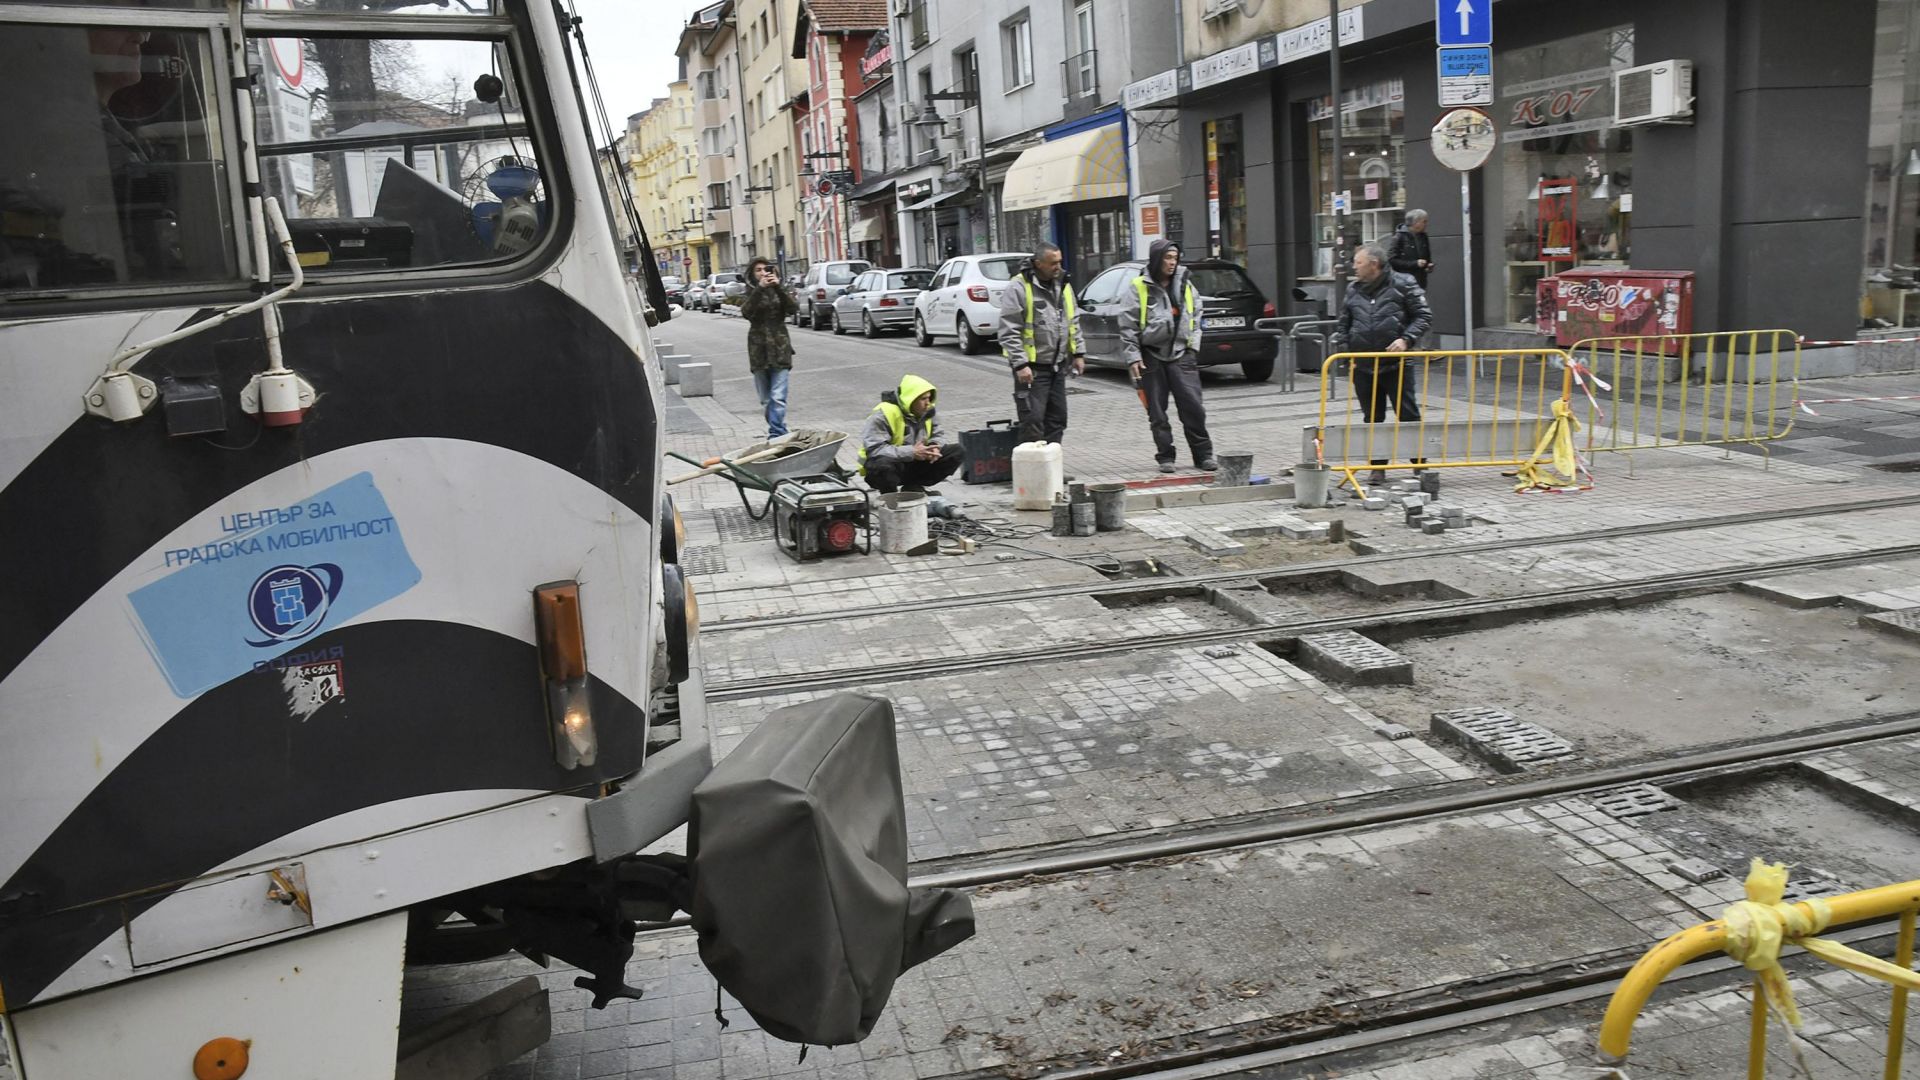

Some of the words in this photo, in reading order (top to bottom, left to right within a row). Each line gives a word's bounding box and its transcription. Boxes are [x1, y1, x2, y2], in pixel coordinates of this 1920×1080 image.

[1282, 15, 1357, 53] КНИЖАРНЦА
[1196, 48, 1254, 80] КНИЖАРНИЦА
[975, 457, 1010, 476] BOS
[220, 505, 304, 534] ЦЕНТЪР
[308, 500, 336, 519] ЗА
[164, 538, 264, 568] ГРАДСКА
[267, 516, 394, 552] МОБИЛНОСТ
[253, 645, 345, 674] СОФИЯ
